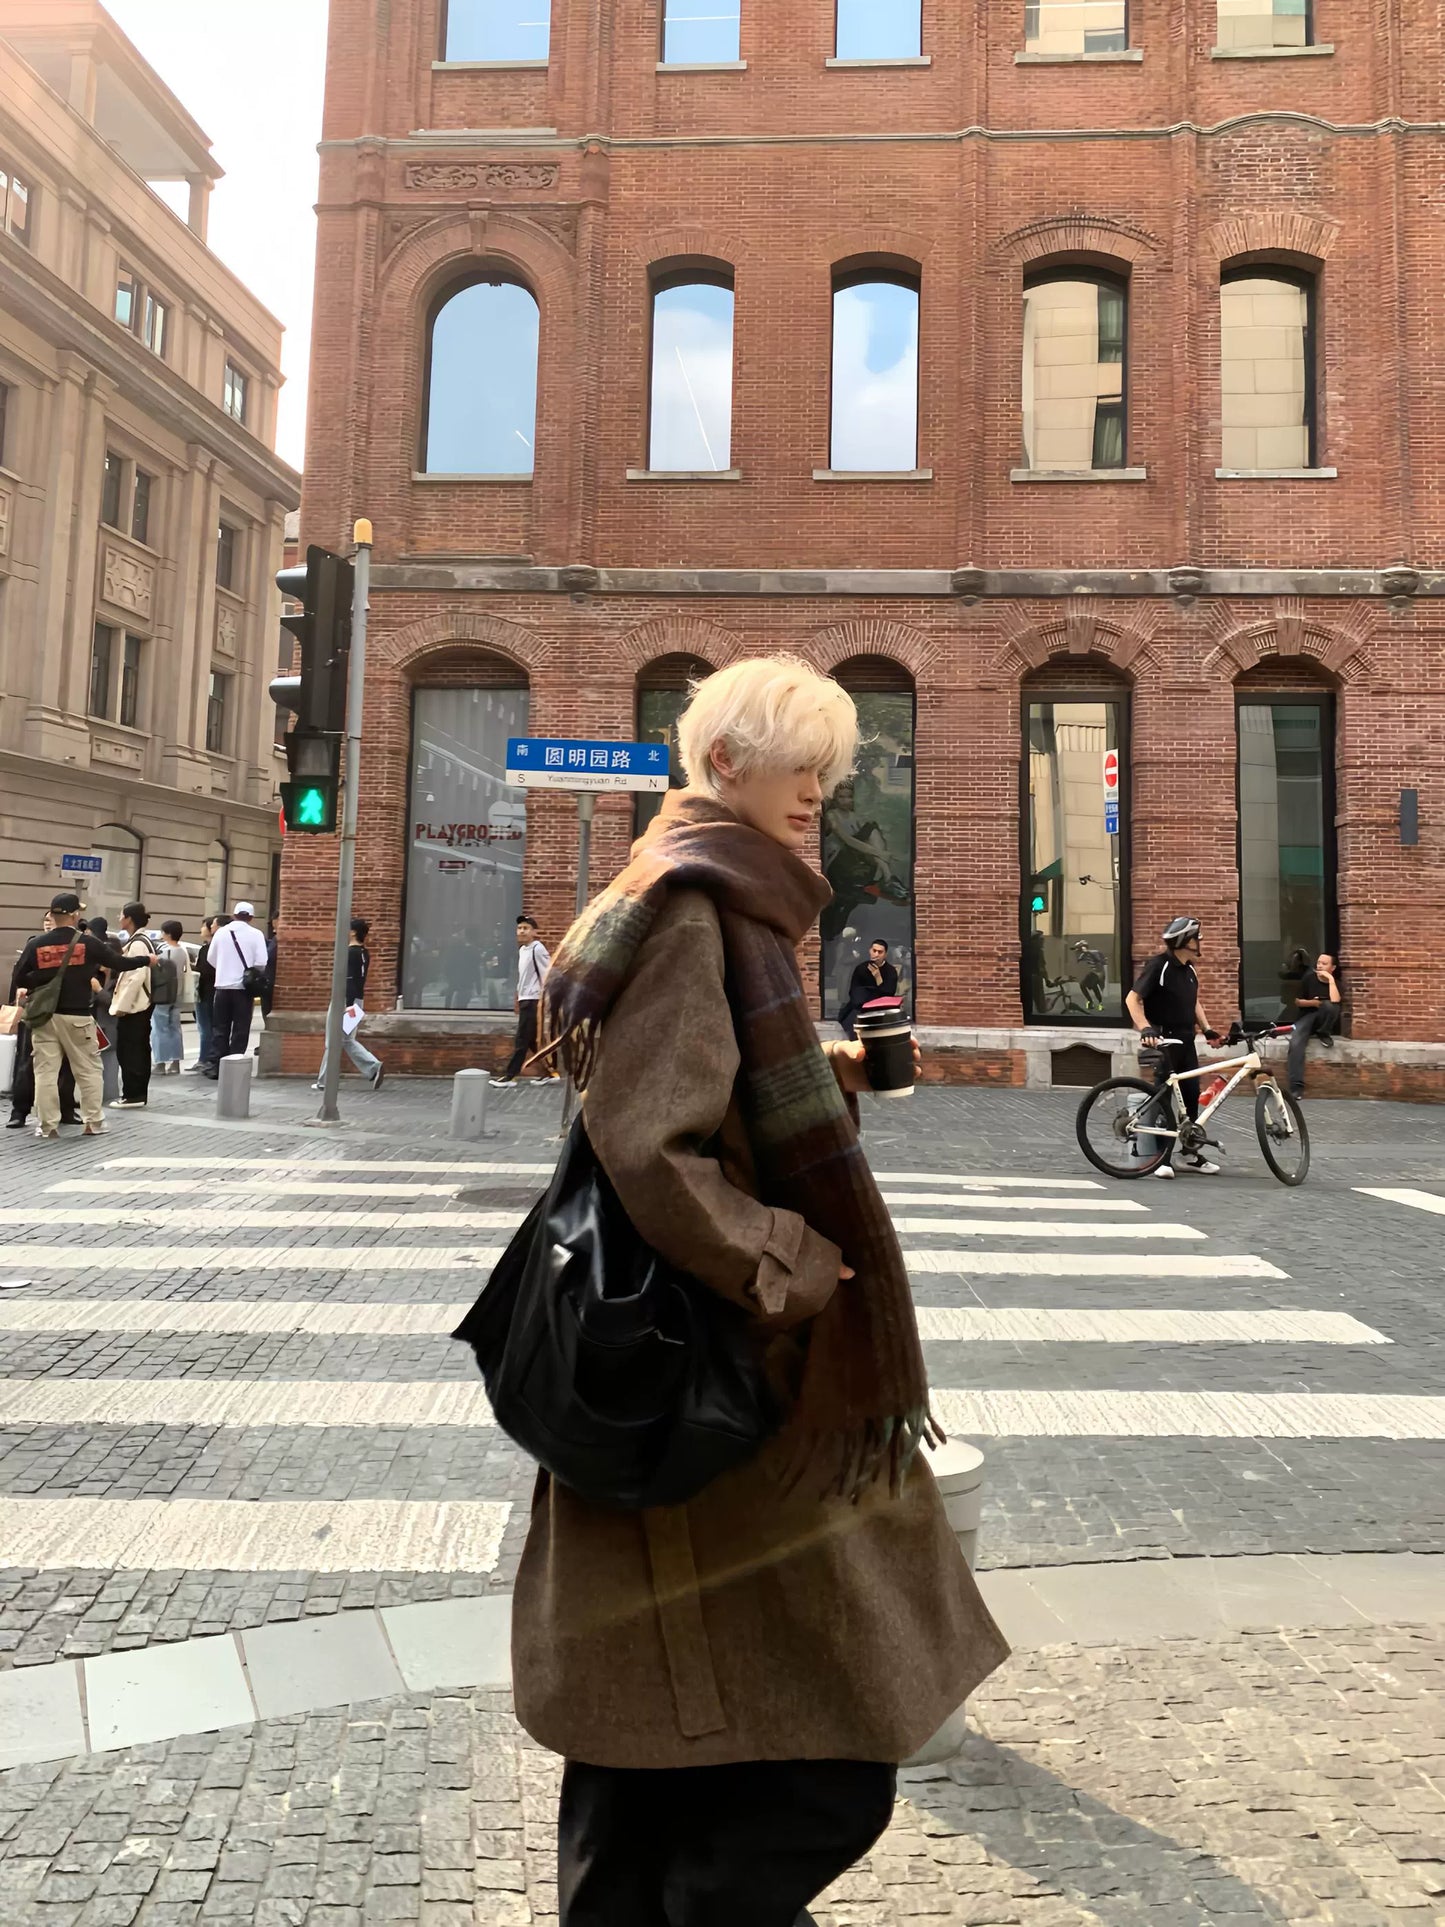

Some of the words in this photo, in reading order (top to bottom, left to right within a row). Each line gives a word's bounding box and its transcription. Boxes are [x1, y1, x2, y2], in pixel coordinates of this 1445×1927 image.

[516, 744, 528, 756] 南
[545, 747, 631, 768] 圆明园路
[648, 750, 660, 762] 北
[517, 774, 526, 784] S
[614, 776, 627, 784] Rd
[648, 779, 658, 788] N
